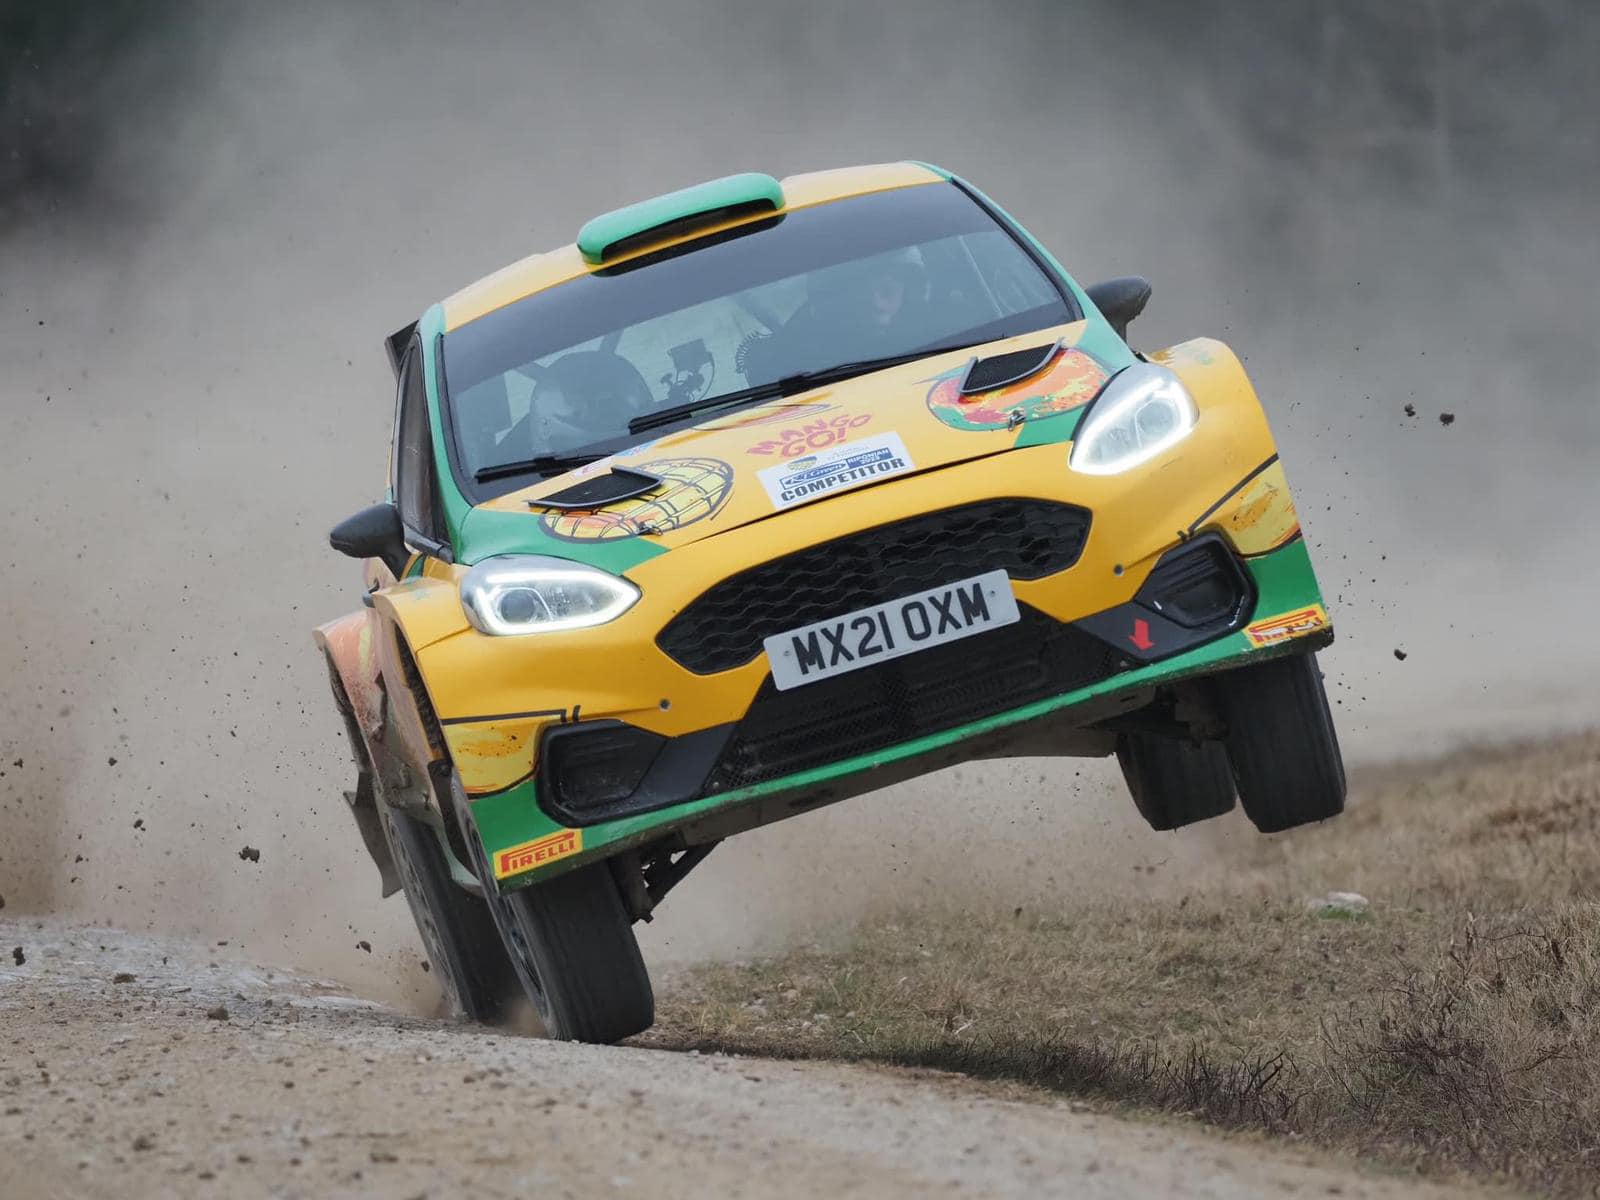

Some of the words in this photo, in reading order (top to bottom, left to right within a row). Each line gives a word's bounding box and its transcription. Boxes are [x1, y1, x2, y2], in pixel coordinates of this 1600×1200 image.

[747, 414, 872, 455] MANGO
[782, 427, 847, 458] GO!
[780, 458, 905, 502] COMPETITOR
[791, 610, 896, 676] MX21
[901, 583, 991, 642] OXM
[501, 831, 575, 872] PIRELLI
